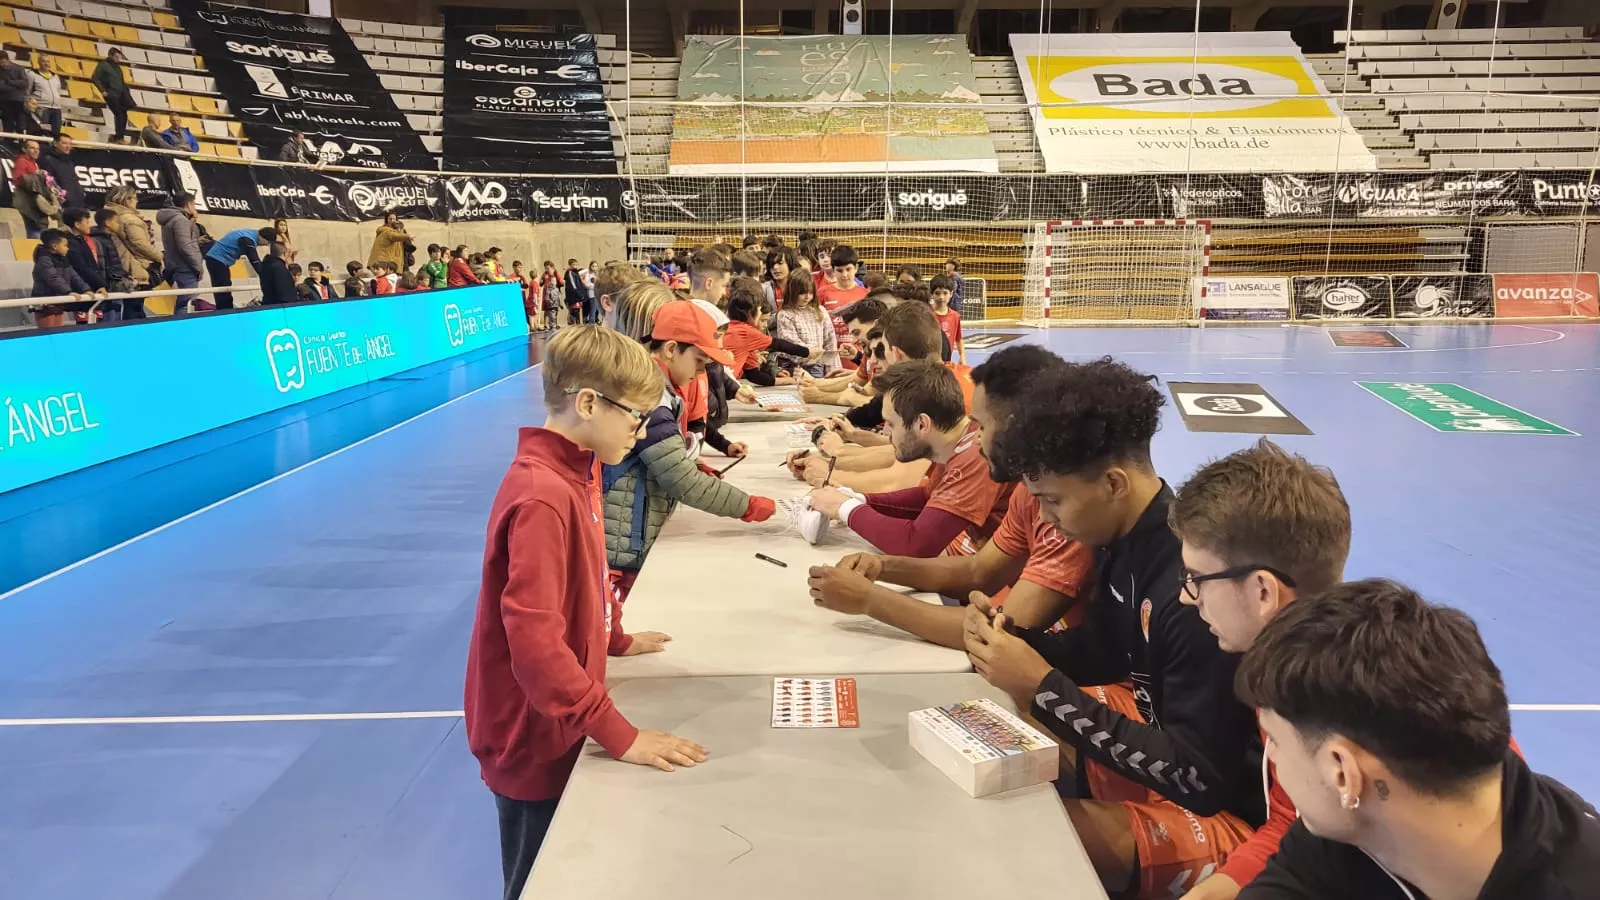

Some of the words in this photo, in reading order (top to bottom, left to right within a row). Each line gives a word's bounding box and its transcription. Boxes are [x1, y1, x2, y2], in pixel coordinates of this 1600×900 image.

[1092, 73, 1256, 96] Bada
[1048, 126, 1124, 136] Plástico
[1129, 126, 1198, 136] técnico
[1205, 126, 1220, 136] &
[1228, 125, 1349, 136] Elastómeros
[1137, 136, 1271, 149] www.bada.de
[74, 165, 160, 189] SERFEY
[374, 186, 429, 200] MIGUEL
[539, 193, 609, 212] seytam
[1496, 287, 1573, 300] avanza
[305, 341, 352, 376] FUENTE
[364, 333, 396, 361] ÁNGEL
[4, 391, 101, 448] ÁNGEL
